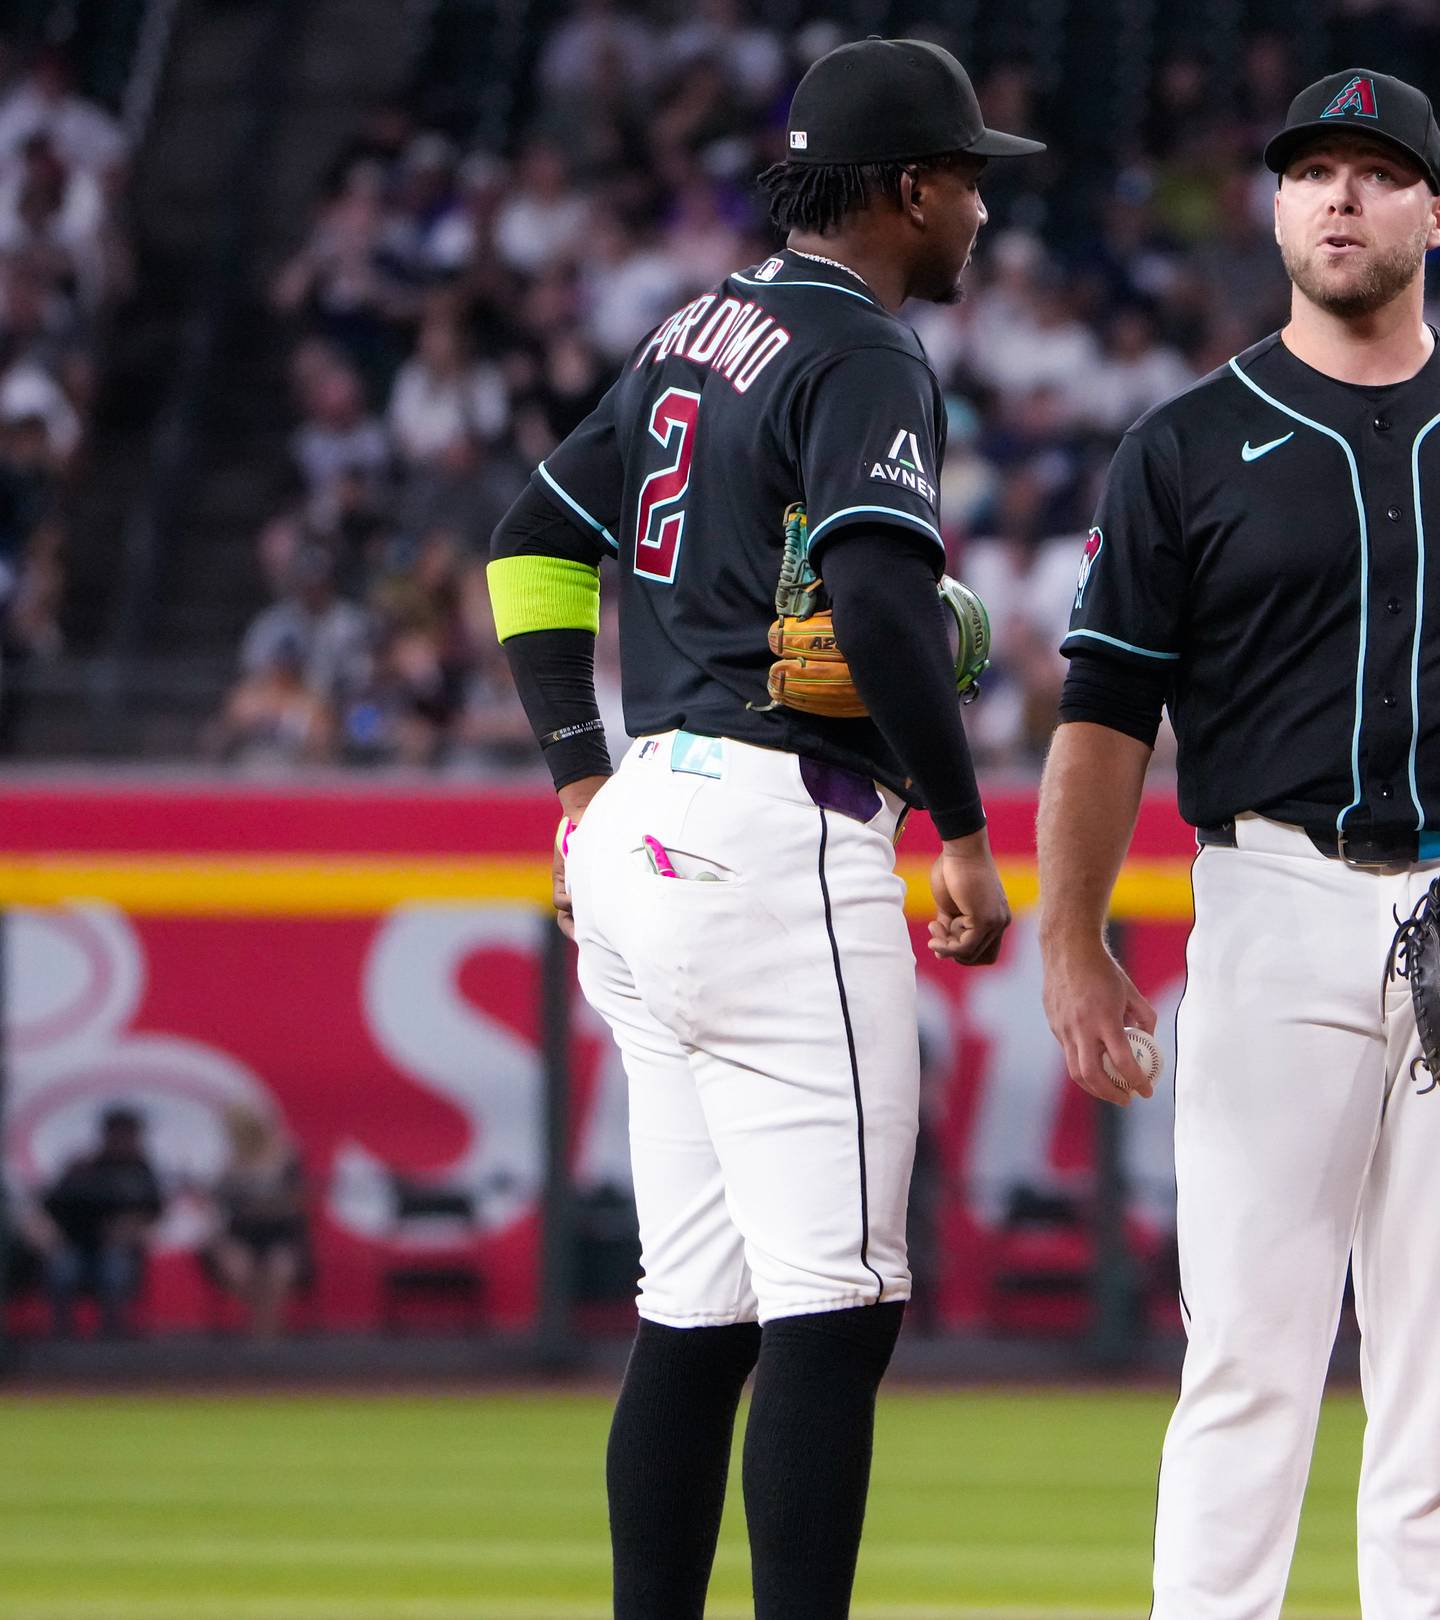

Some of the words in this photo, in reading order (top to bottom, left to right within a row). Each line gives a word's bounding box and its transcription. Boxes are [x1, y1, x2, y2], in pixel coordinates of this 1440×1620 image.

[633, 386, 702, 585] 2
[869, 462, 937, 504] AVNET
[809, 636, 838, 650] A2
